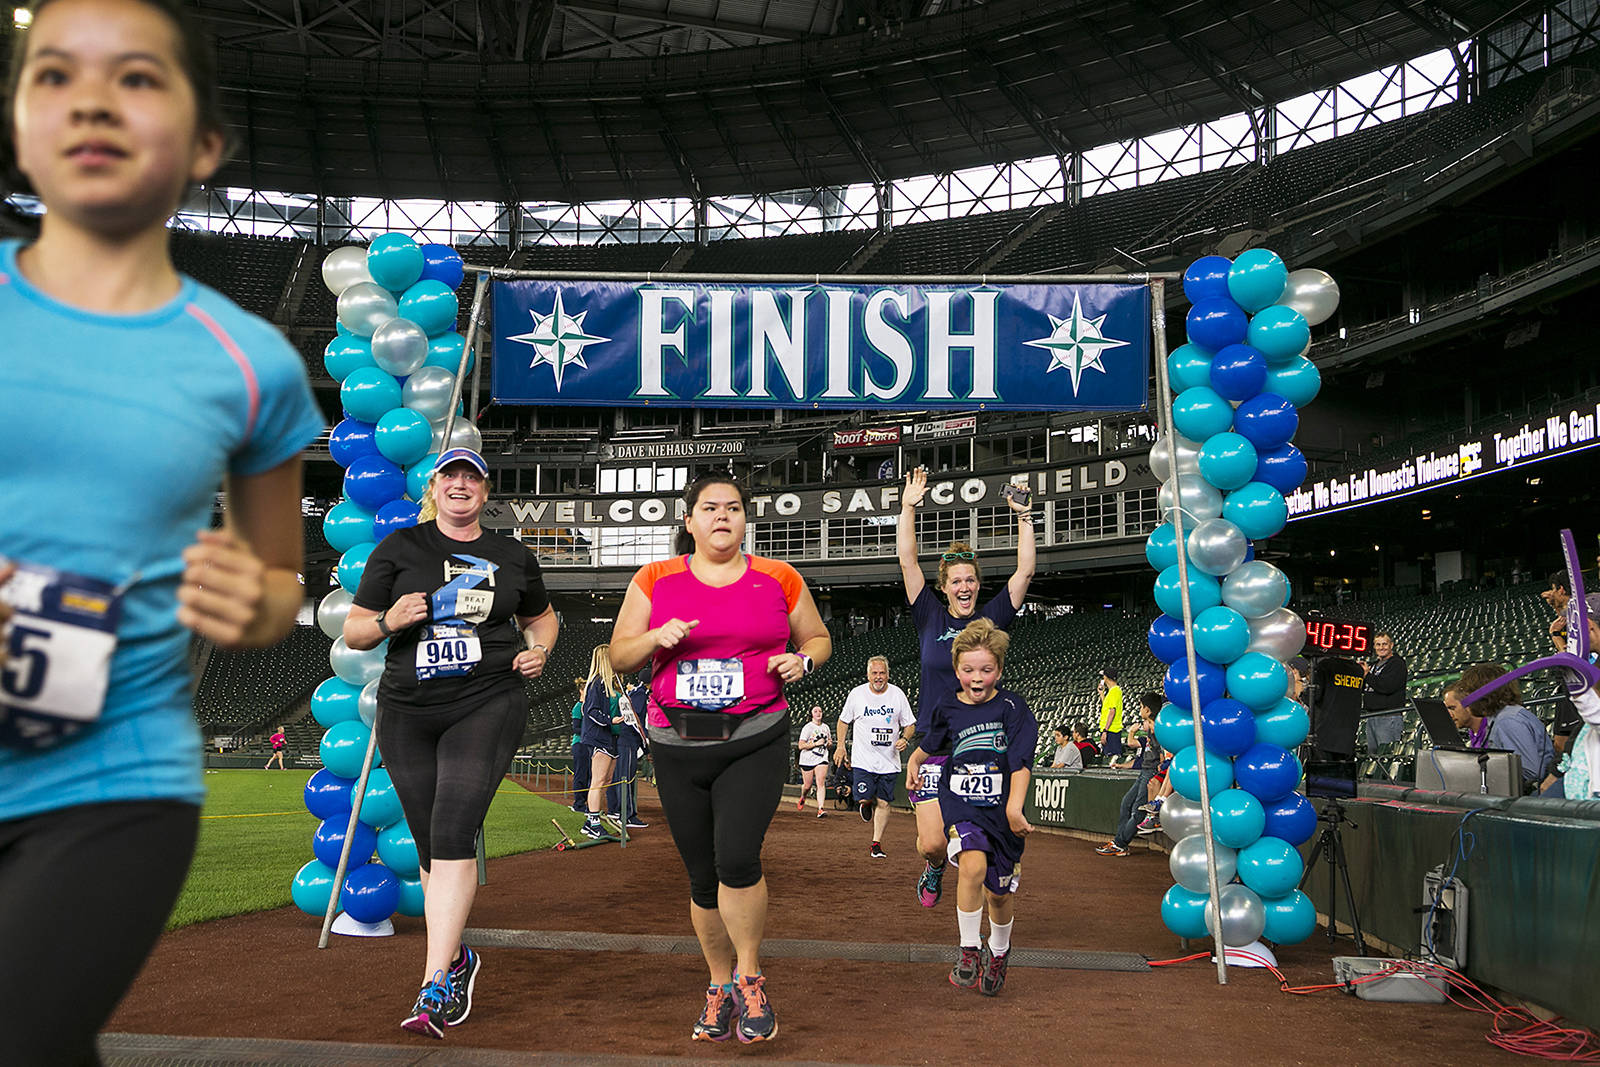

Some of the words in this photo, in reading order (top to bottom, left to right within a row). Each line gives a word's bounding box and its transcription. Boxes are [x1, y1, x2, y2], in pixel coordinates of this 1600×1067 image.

[631, 288, 1003, 400] FINISH
[834, 433, 862, 445] ROOT
[863, 432, 898, 443] SPORTS
[917, 423, 933, 433] 710
[1493, 424, 1545, 466] Together
[1546, 415, 1568, 450] We
[1569, 410, 1595, 444] Can
[618, 445, 645, 458] DAVE
[648, 443, 694, 457] NIEHAUS
[697, 442, 743, 455] 1977-2010
[1314, 482, 1329, 509] We
[1330, 478, 1349, 505] Can
[1350, 471, 1368, 501] End
[1369, 460, 1416, 497] Domestic
[1416, 452, 1459, 485] Violence
[509, 498, 688, 523] WELCO
[750, 493, 801, 518] TO
[822, 478, 987, 513] SAFCO
[465, 596, 486, 604] BEAT
[426, 640, 468, 664] 940
[686, 675, 734, 697] 1497
[960, 775, 993, 795] 429
[1034, 778, 1069, 809] ROOT
[1040, 809, 1065, 822] SPORTS
